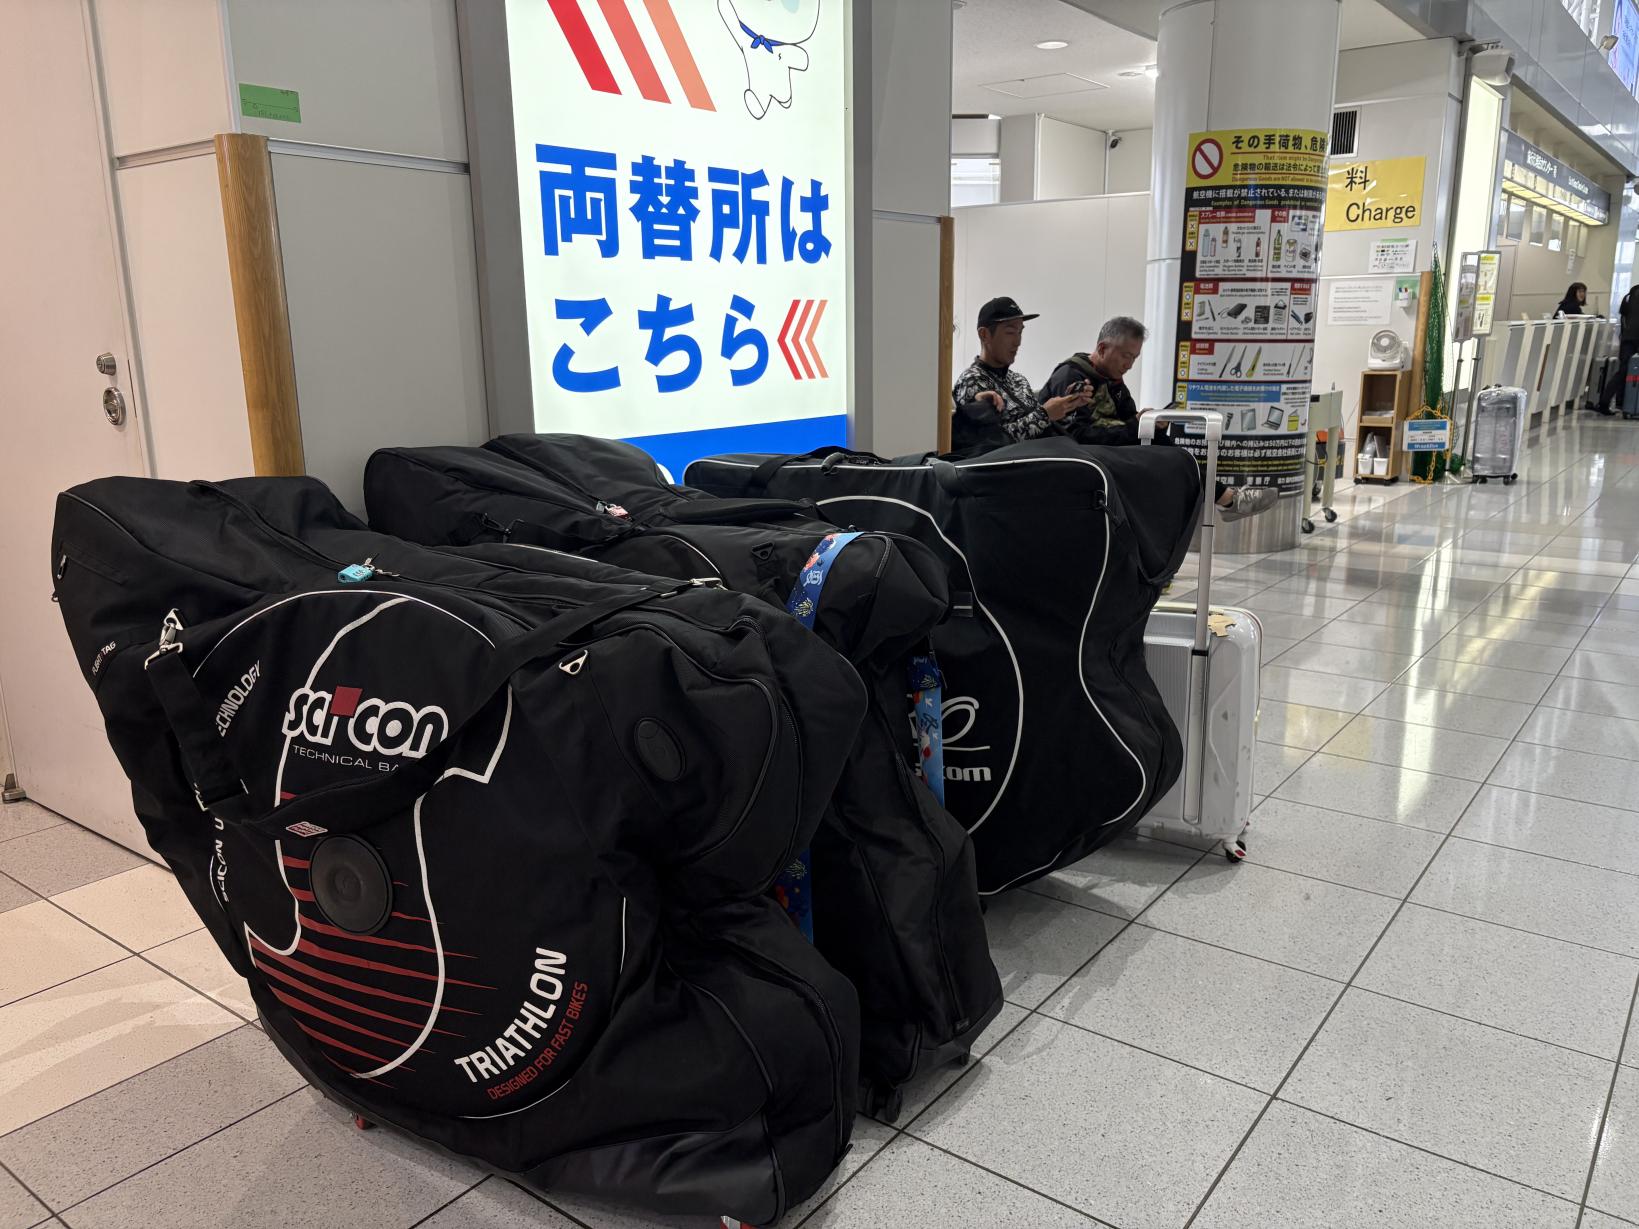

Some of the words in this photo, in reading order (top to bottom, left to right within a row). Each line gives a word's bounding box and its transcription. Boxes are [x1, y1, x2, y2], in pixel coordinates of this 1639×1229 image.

[535, 143, 832, 265] 両替所は
[1345, 166, 1370, 192] 料
[1346, 202, 1416, 224] Charge
[552, 293, 769, 393] こちら
[101, 641, 116, 655] TAG
[215, 660, 261, 737] ECHNOLOGY
[292, 744, 373, 770] TECHNICAL
[453, 947, 567, 1083] TRIATHLON
[486, 1065, 539, 1100] DESIGNED
[534, 1047, 558, 1071] FOR
[550, 1018, 575, 1050] FAST
[565, 981, 588, 1020] BIKES
